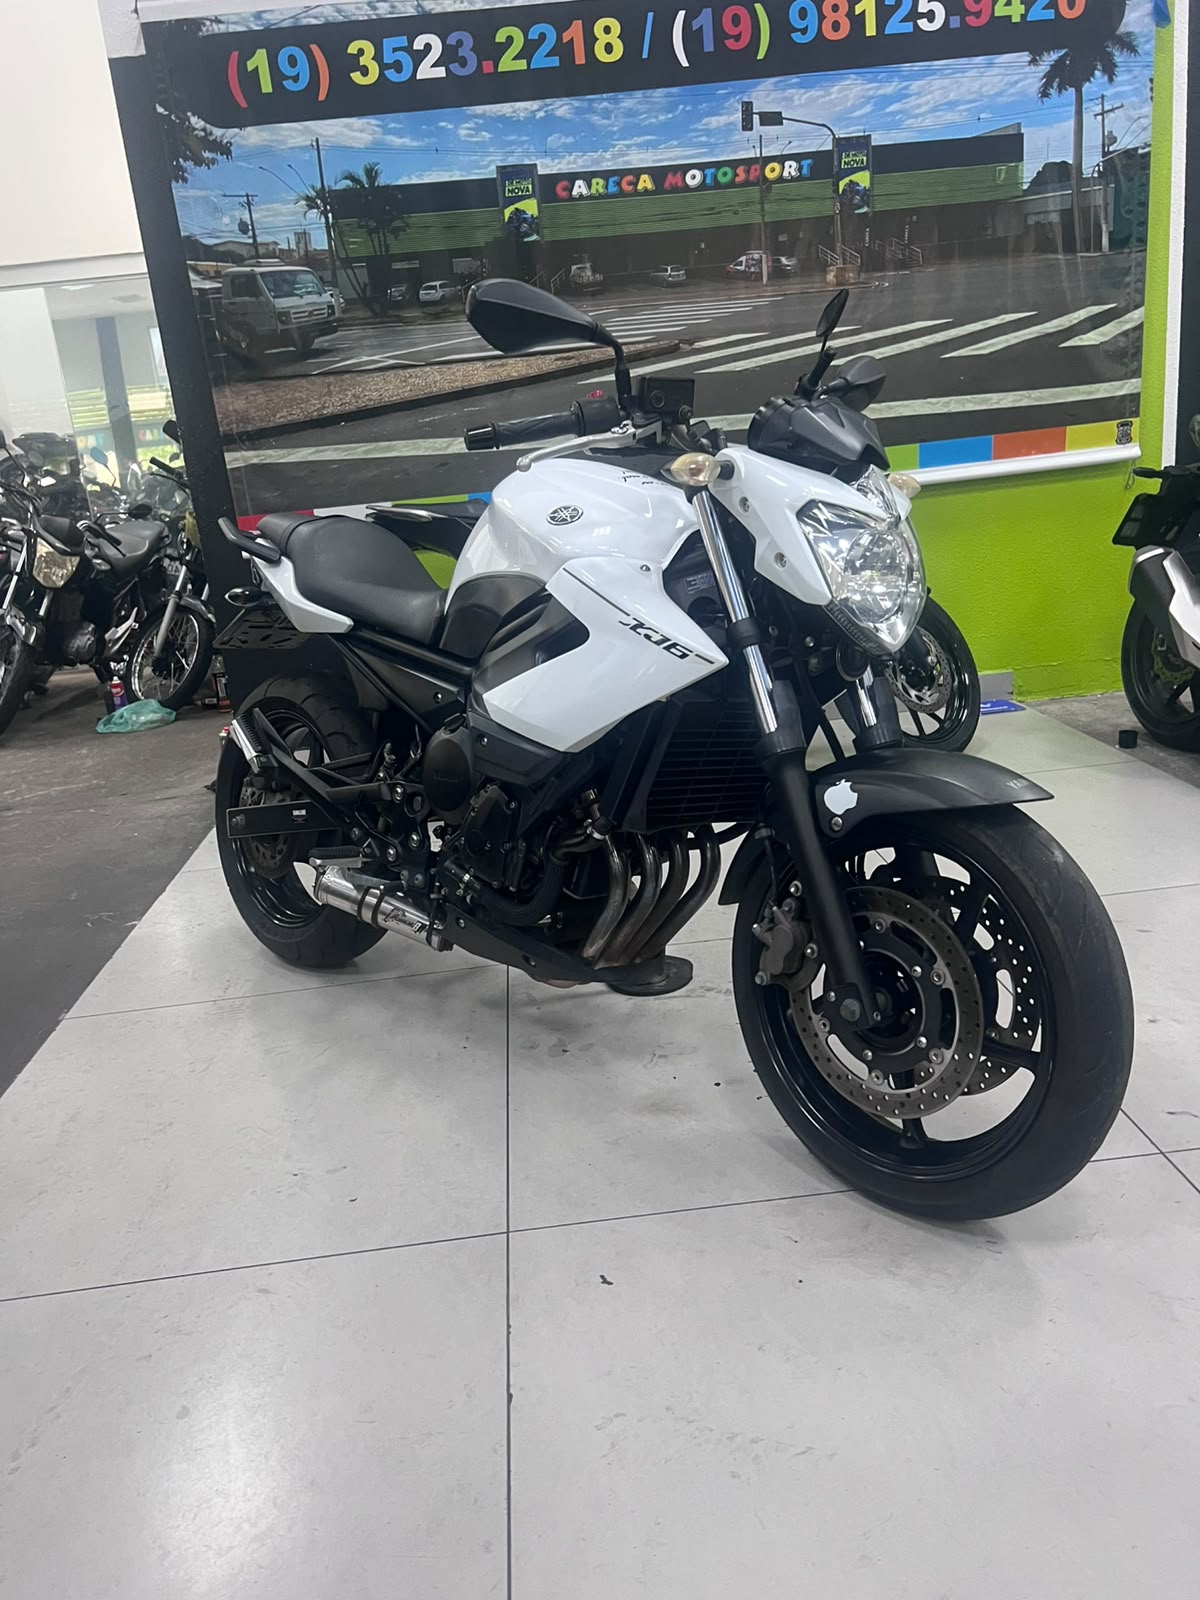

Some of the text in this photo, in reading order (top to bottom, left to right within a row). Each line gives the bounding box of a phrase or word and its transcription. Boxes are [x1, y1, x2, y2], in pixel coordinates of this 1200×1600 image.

[228, 45, 329, 107] (19)
[347, 18, 624, 85] 3523.2218
[673, 3, 770, 67] (19)
[555, 159, 813, 198] CARECA MOTOSPORT
[843, 158, 865, 167] NOVA
[507, 185, 531, 195] NOVA
[619, 617, 693, 660] XJ6
